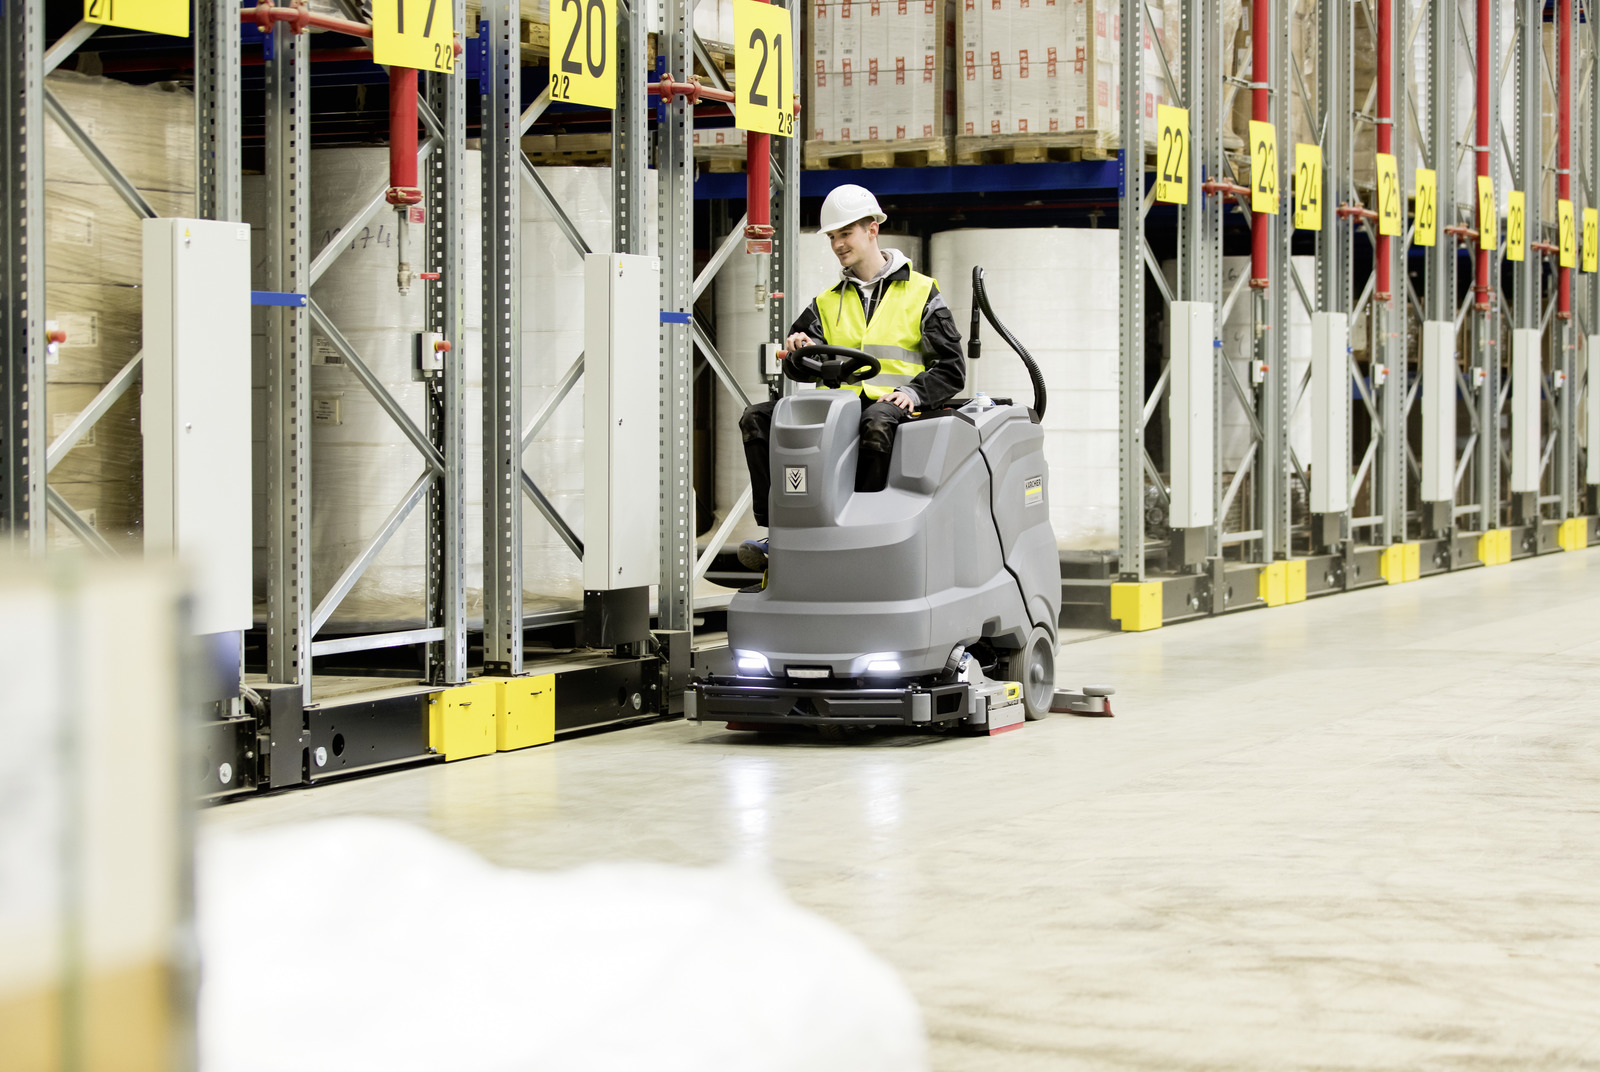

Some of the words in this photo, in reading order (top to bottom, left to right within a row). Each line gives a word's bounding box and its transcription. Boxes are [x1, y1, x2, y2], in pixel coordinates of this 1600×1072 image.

[434, 42, 452, 71] 2/2
[561, 0, 606, 79] 20
[552, 73, 570, 99] 2/2
[749, 28, 782, 110] 21
[778, 111, 793, 135] 2/3
[1163, 125, 1183, 184] 22
[1257, 140, 1276, 195] 23
[1300, 161, 1317, 213] 24
[1383, 170, 1398, 219] 25
[1419, 184, 1433, 230] 26
[1510, 205, 1521, 245] 28
